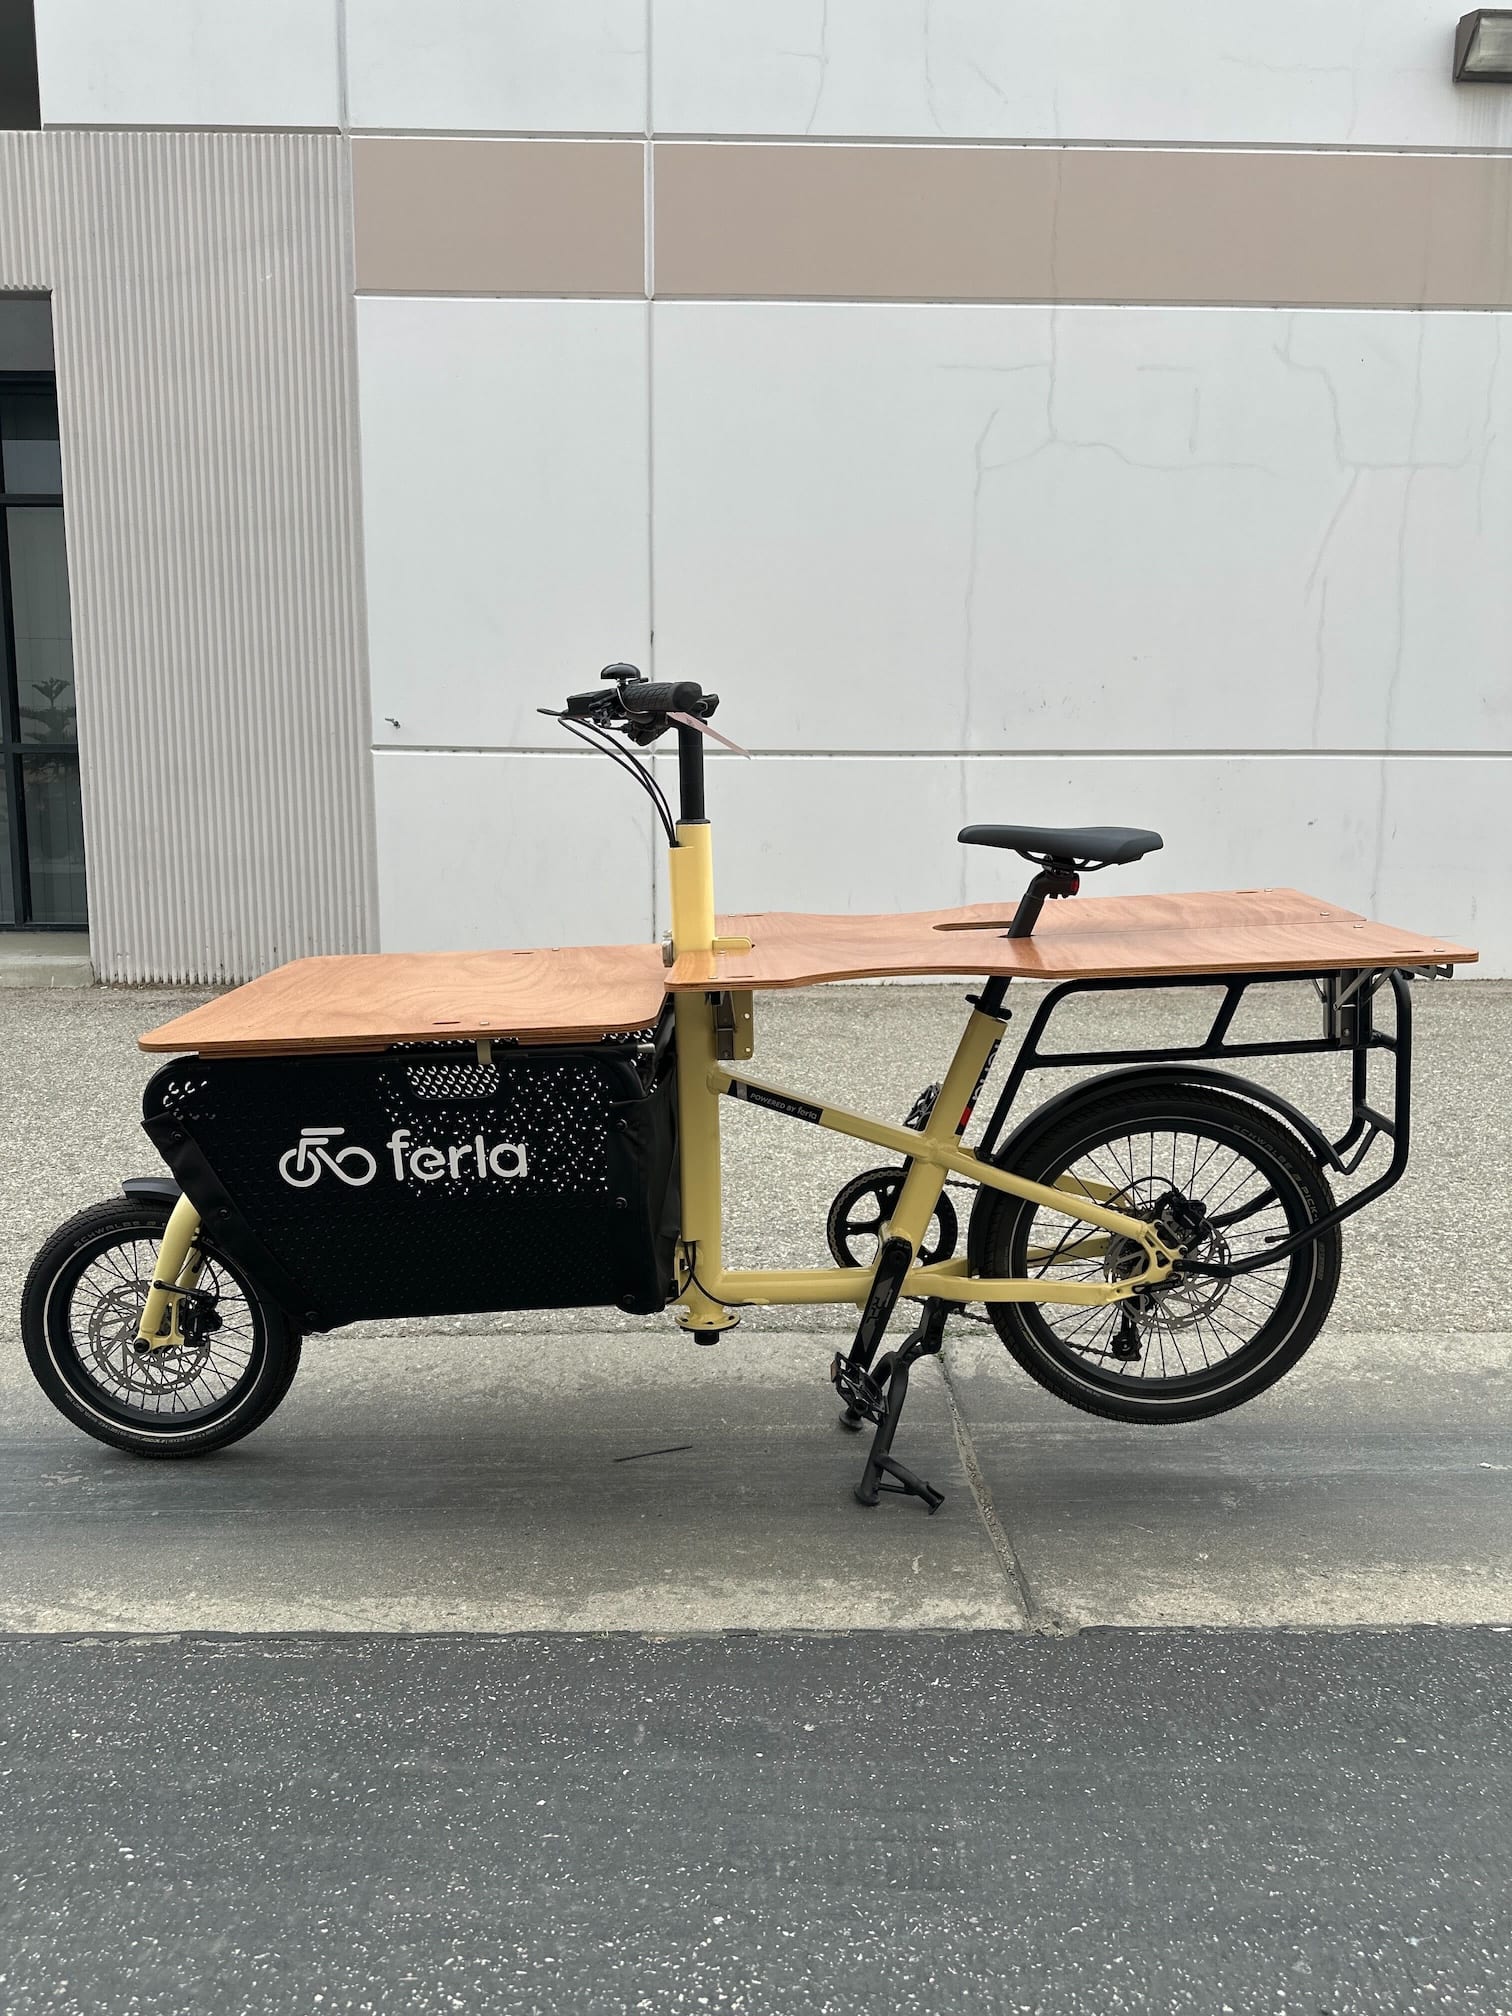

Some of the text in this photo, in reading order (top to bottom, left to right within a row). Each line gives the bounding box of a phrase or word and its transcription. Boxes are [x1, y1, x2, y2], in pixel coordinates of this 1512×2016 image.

[750, 1092, 818, 1120] POWERED BY ferla
[386, 1129, 528, 1181] ferla
[1232, 1124, 1294, 1172] SCHWALBE
